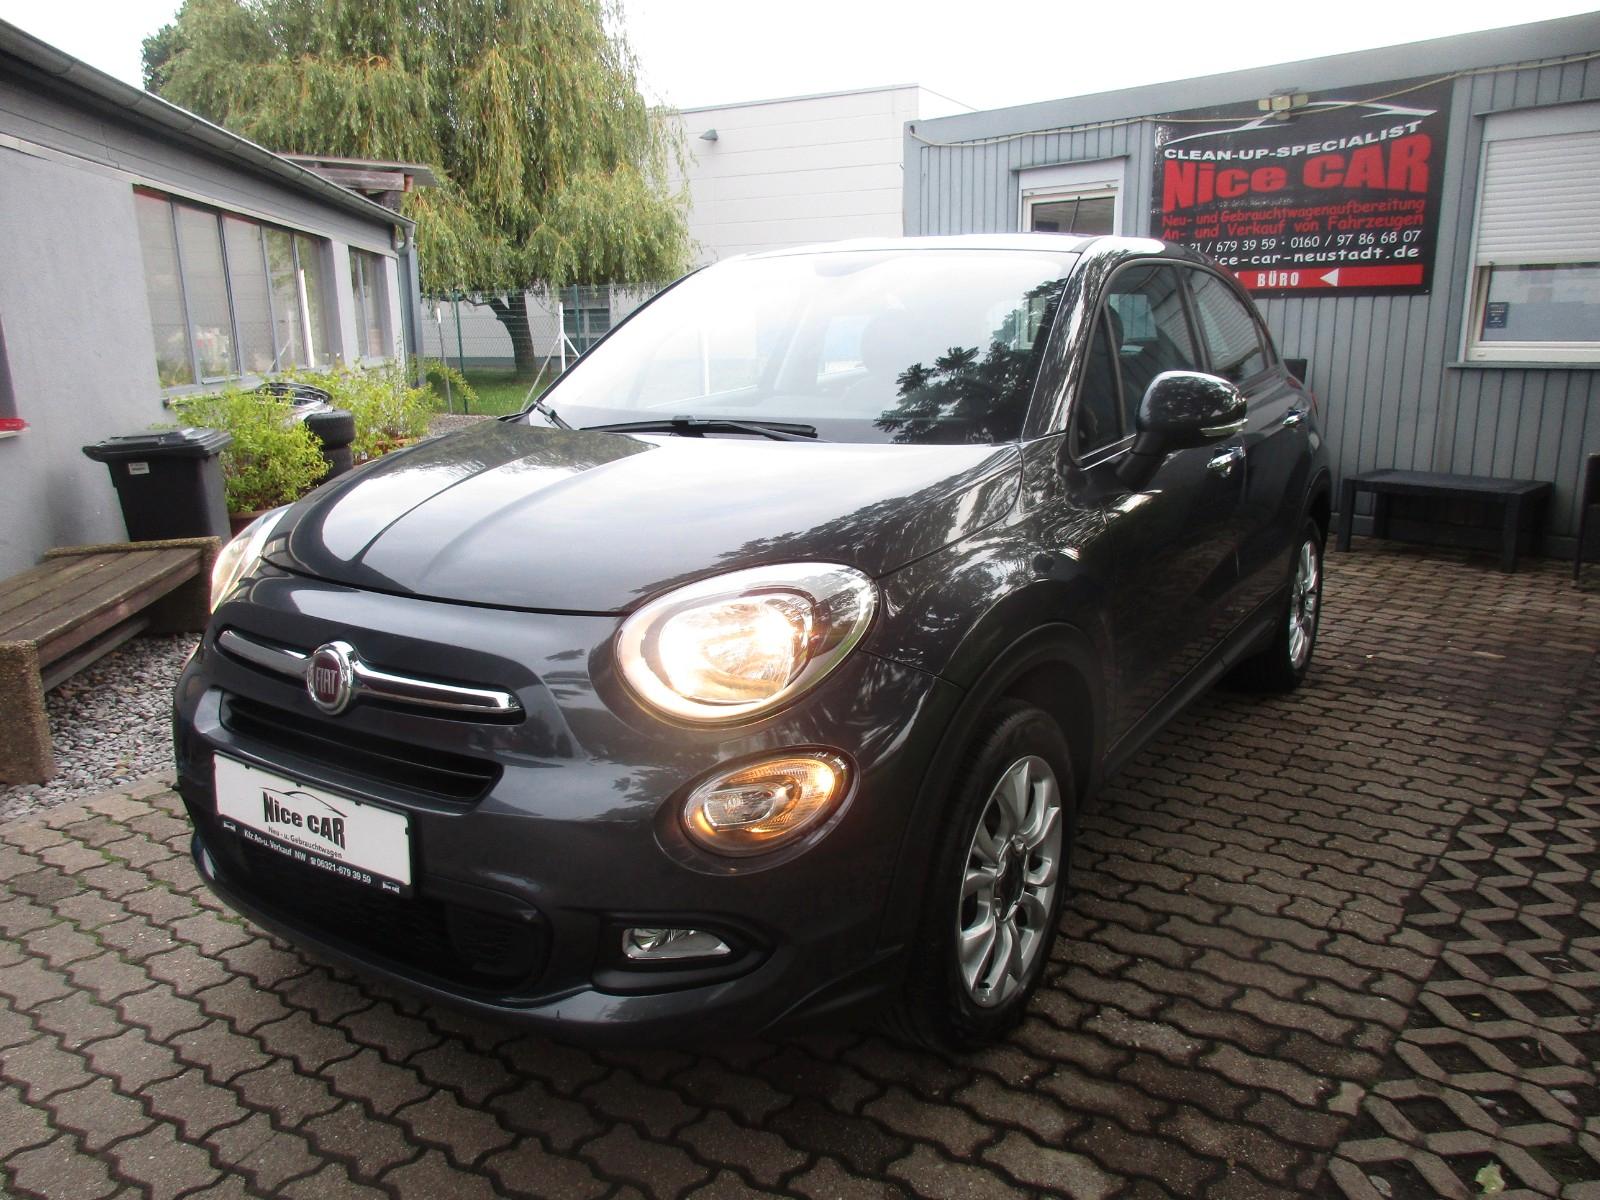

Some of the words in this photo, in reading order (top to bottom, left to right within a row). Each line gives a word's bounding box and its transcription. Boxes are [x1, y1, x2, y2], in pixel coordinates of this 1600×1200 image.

[1164, 120, 1422, 161] CLEAN-UP-SPECIALIST
[1162, 159, 1287, 214] Nice
[1303, 133, 1432, 193] CAR
[1196, 211, 1218, 224] und
[1221, 199, 1425, 223] Gebrauchtwagenaufbereitung
[1195, 224, 1219, 239] und
[1227, 219, 1286, 237] Verkauf
[1295, 220, 1319, 233] von
[1327, 213, 1424, 232] Fahrzeugen
[1216, 240, 1238, 253] 679
[1242, 239, 1257, 252] 39
[1261, 238, 1277, 250] 59
[1290, 235, 1320, 249] 0160
[1337, 233, 1354, 247] 97
[1358, 232, 1375, 246] 86
[1380, 231, 1397, 244] 68
[1403, 230, 1422, 243] 07
[1214, 245, 1420, 266] ice-car-neustadt.de
[1257, 270, 1299, 288] BÜRO
[316, 667, 338, 695] FIAT
[262, 791, 304, 828] Nice
[307, 813, 346, 851] CAR
[290, 834, 344, 860] Gebrauchtwagen
[352, 870, 362, 881] 39
[362, 874, 372, 884] 59
